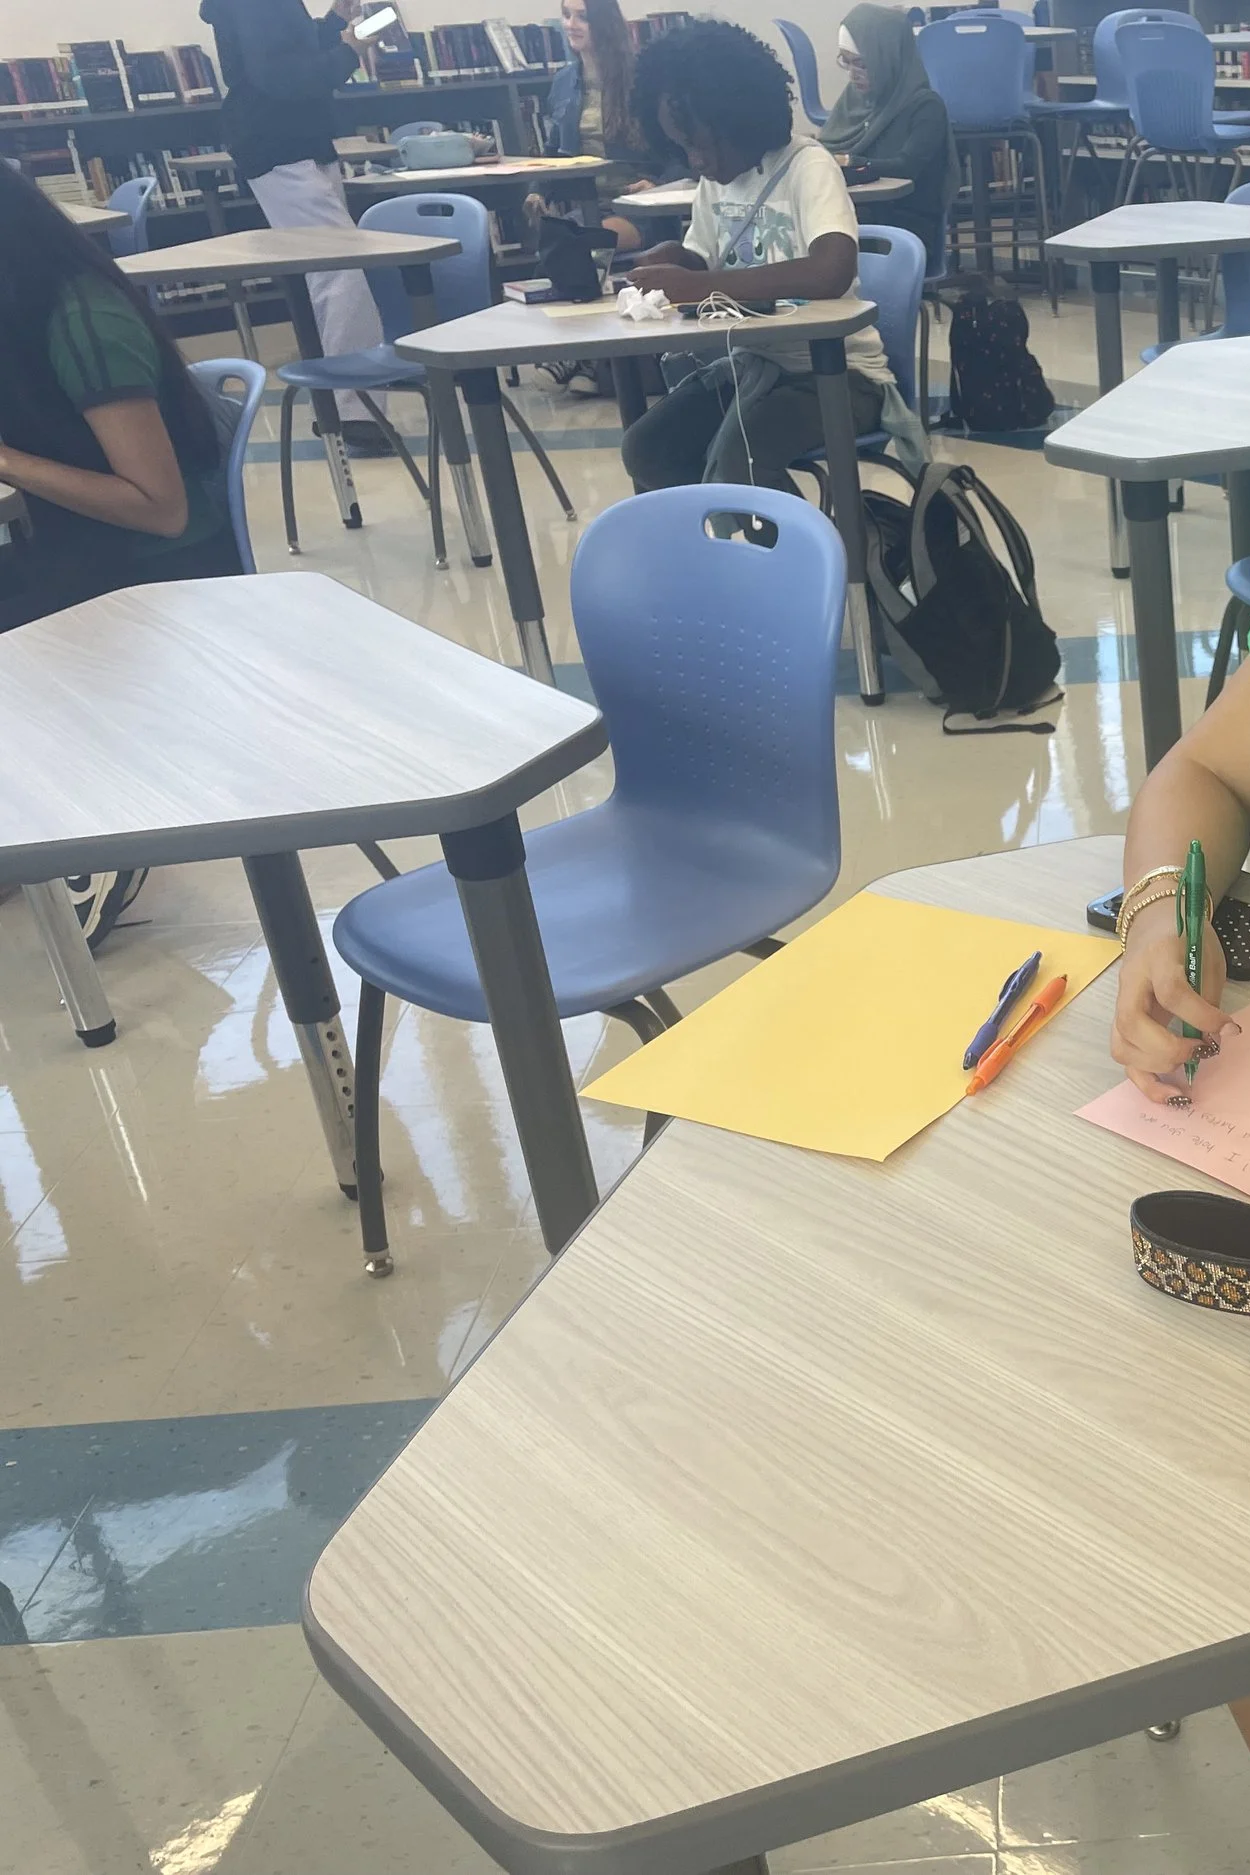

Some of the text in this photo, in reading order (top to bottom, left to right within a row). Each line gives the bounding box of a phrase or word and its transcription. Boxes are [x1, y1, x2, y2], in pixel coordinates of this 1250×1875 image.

[1160, 1122, 1187, 1138] you
[1200, 1111, 1238, 1136] happy
[1191, 1135, 1216, 1153] hope
[1225, 1152, 1240, 1162] I
